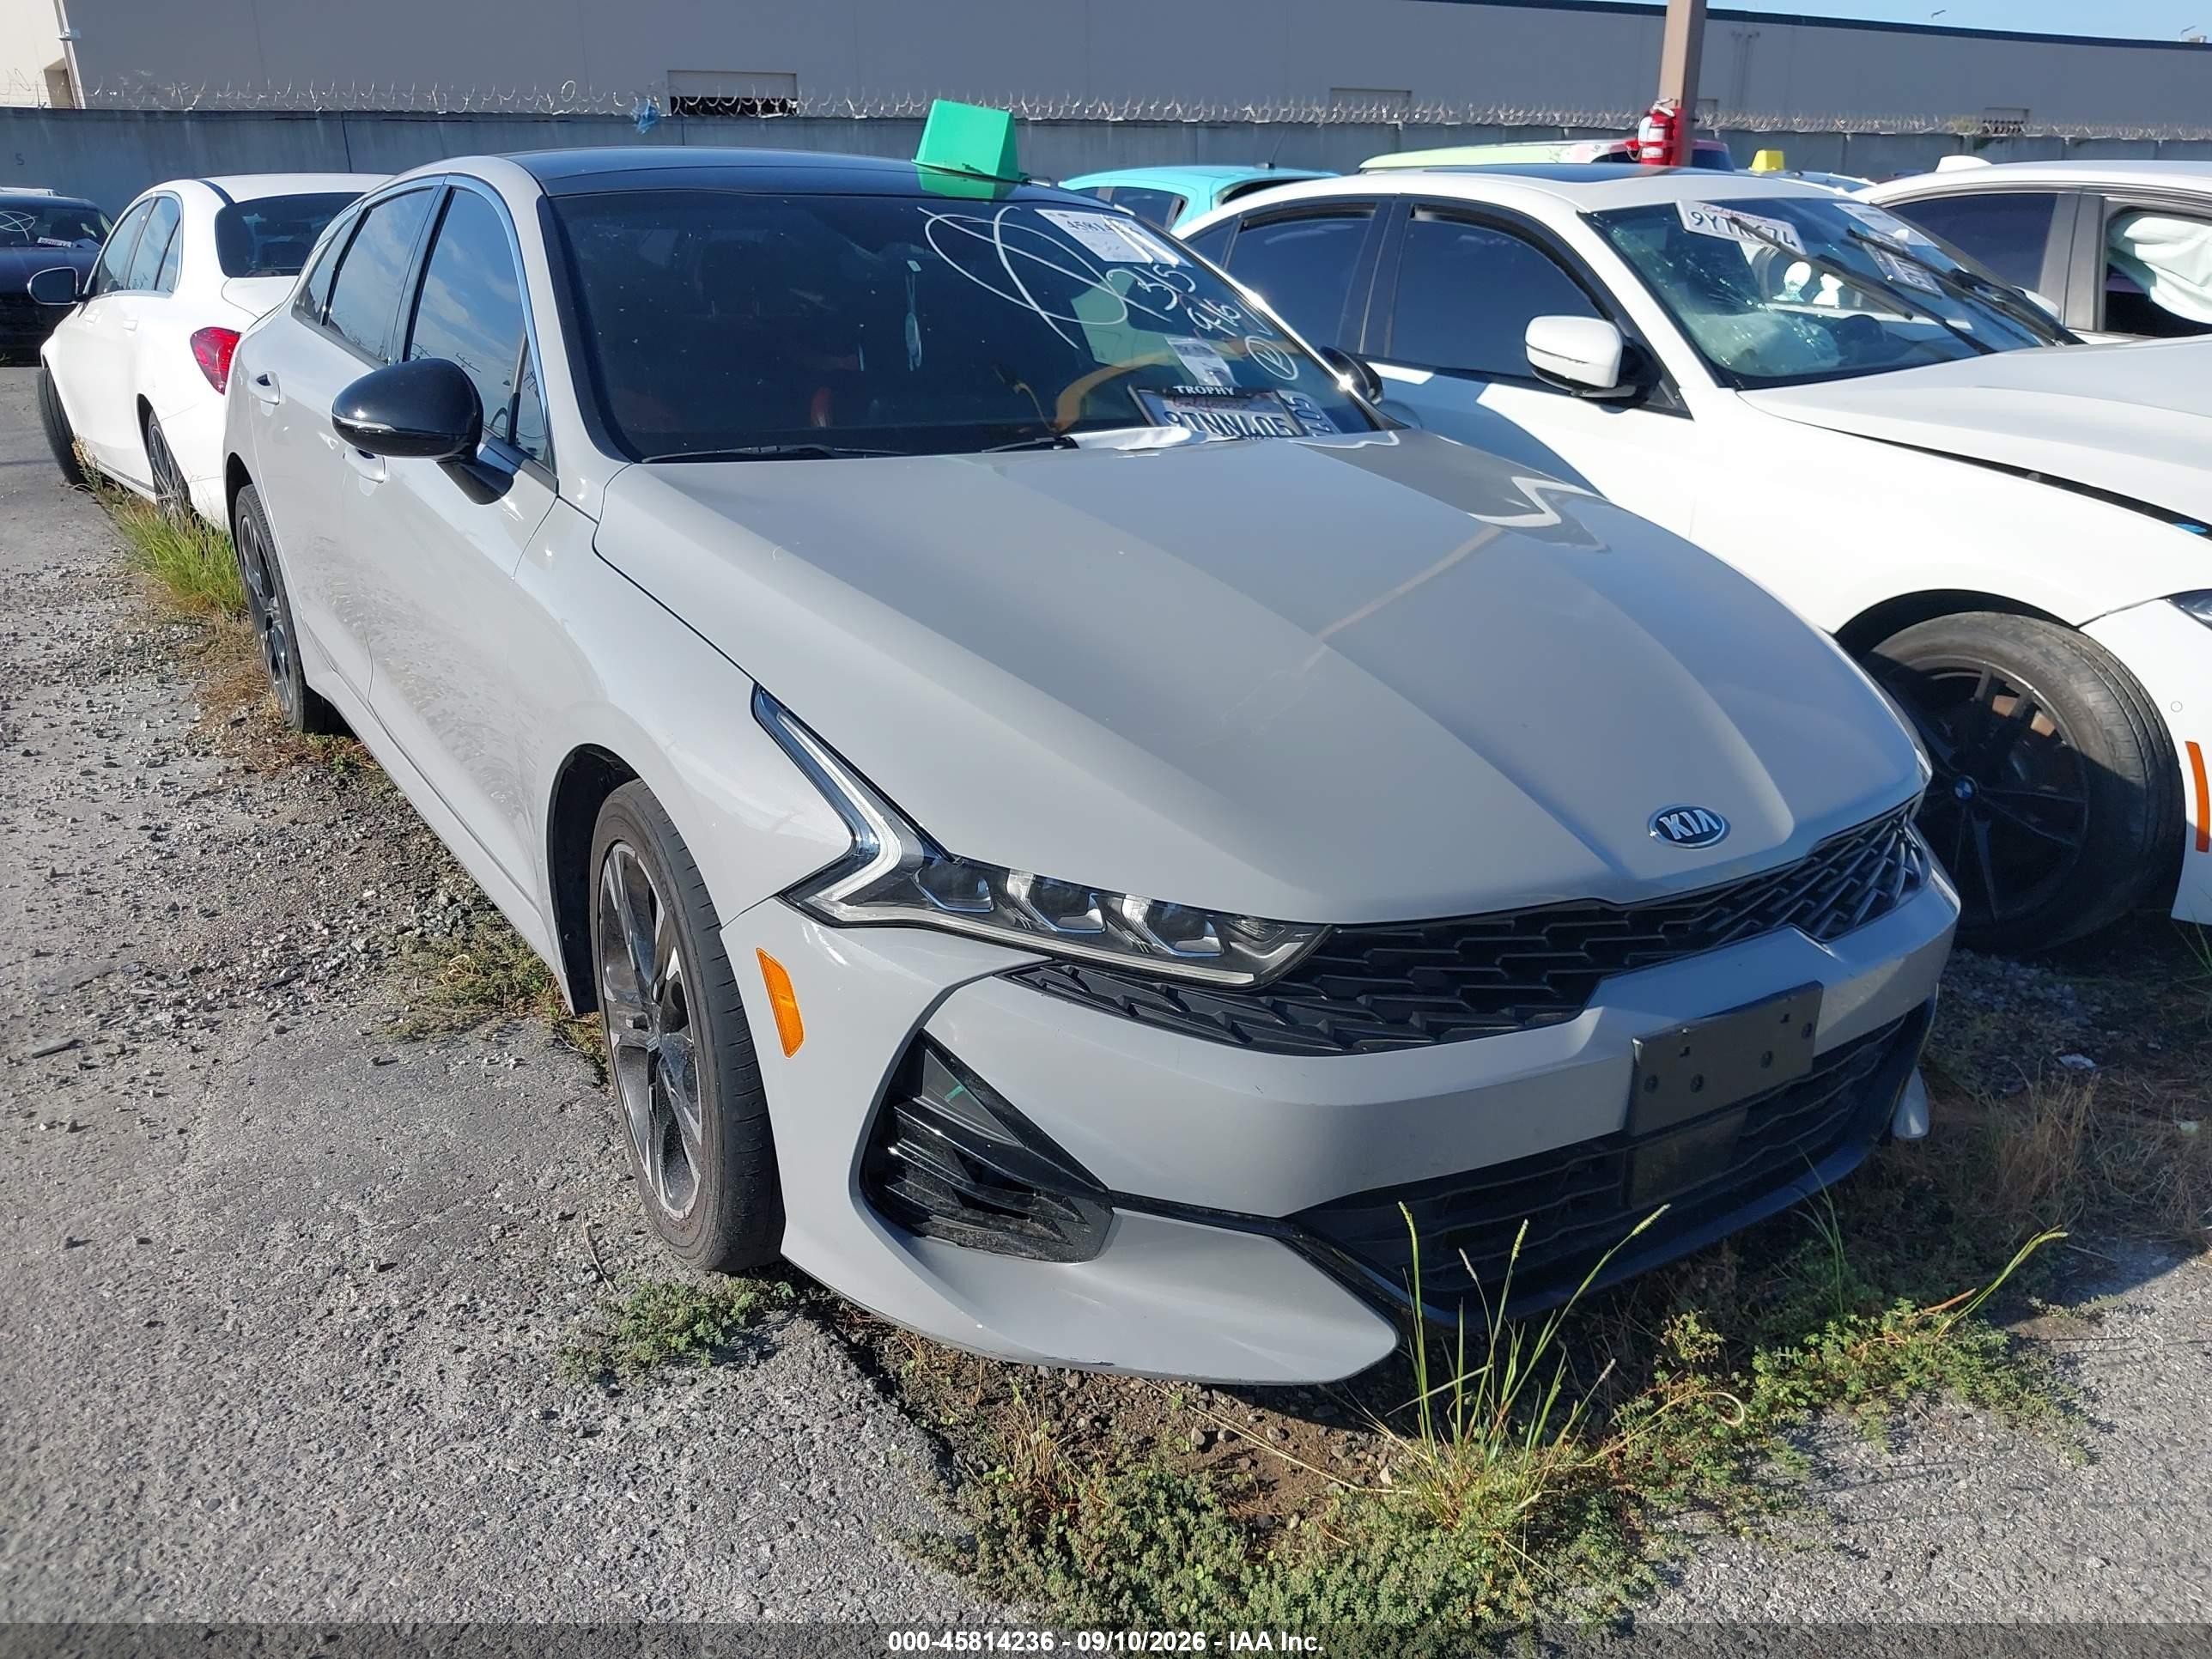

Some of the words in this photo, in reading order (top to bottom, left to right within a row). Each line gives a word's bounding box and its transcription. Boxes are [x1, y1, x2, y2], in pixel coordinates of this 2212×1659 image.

[1691, 211, 1796, 246] 9YT74
[1173, 386, 1235, 396] TROPHY
[1658, 809, 1720, 840] KIA
